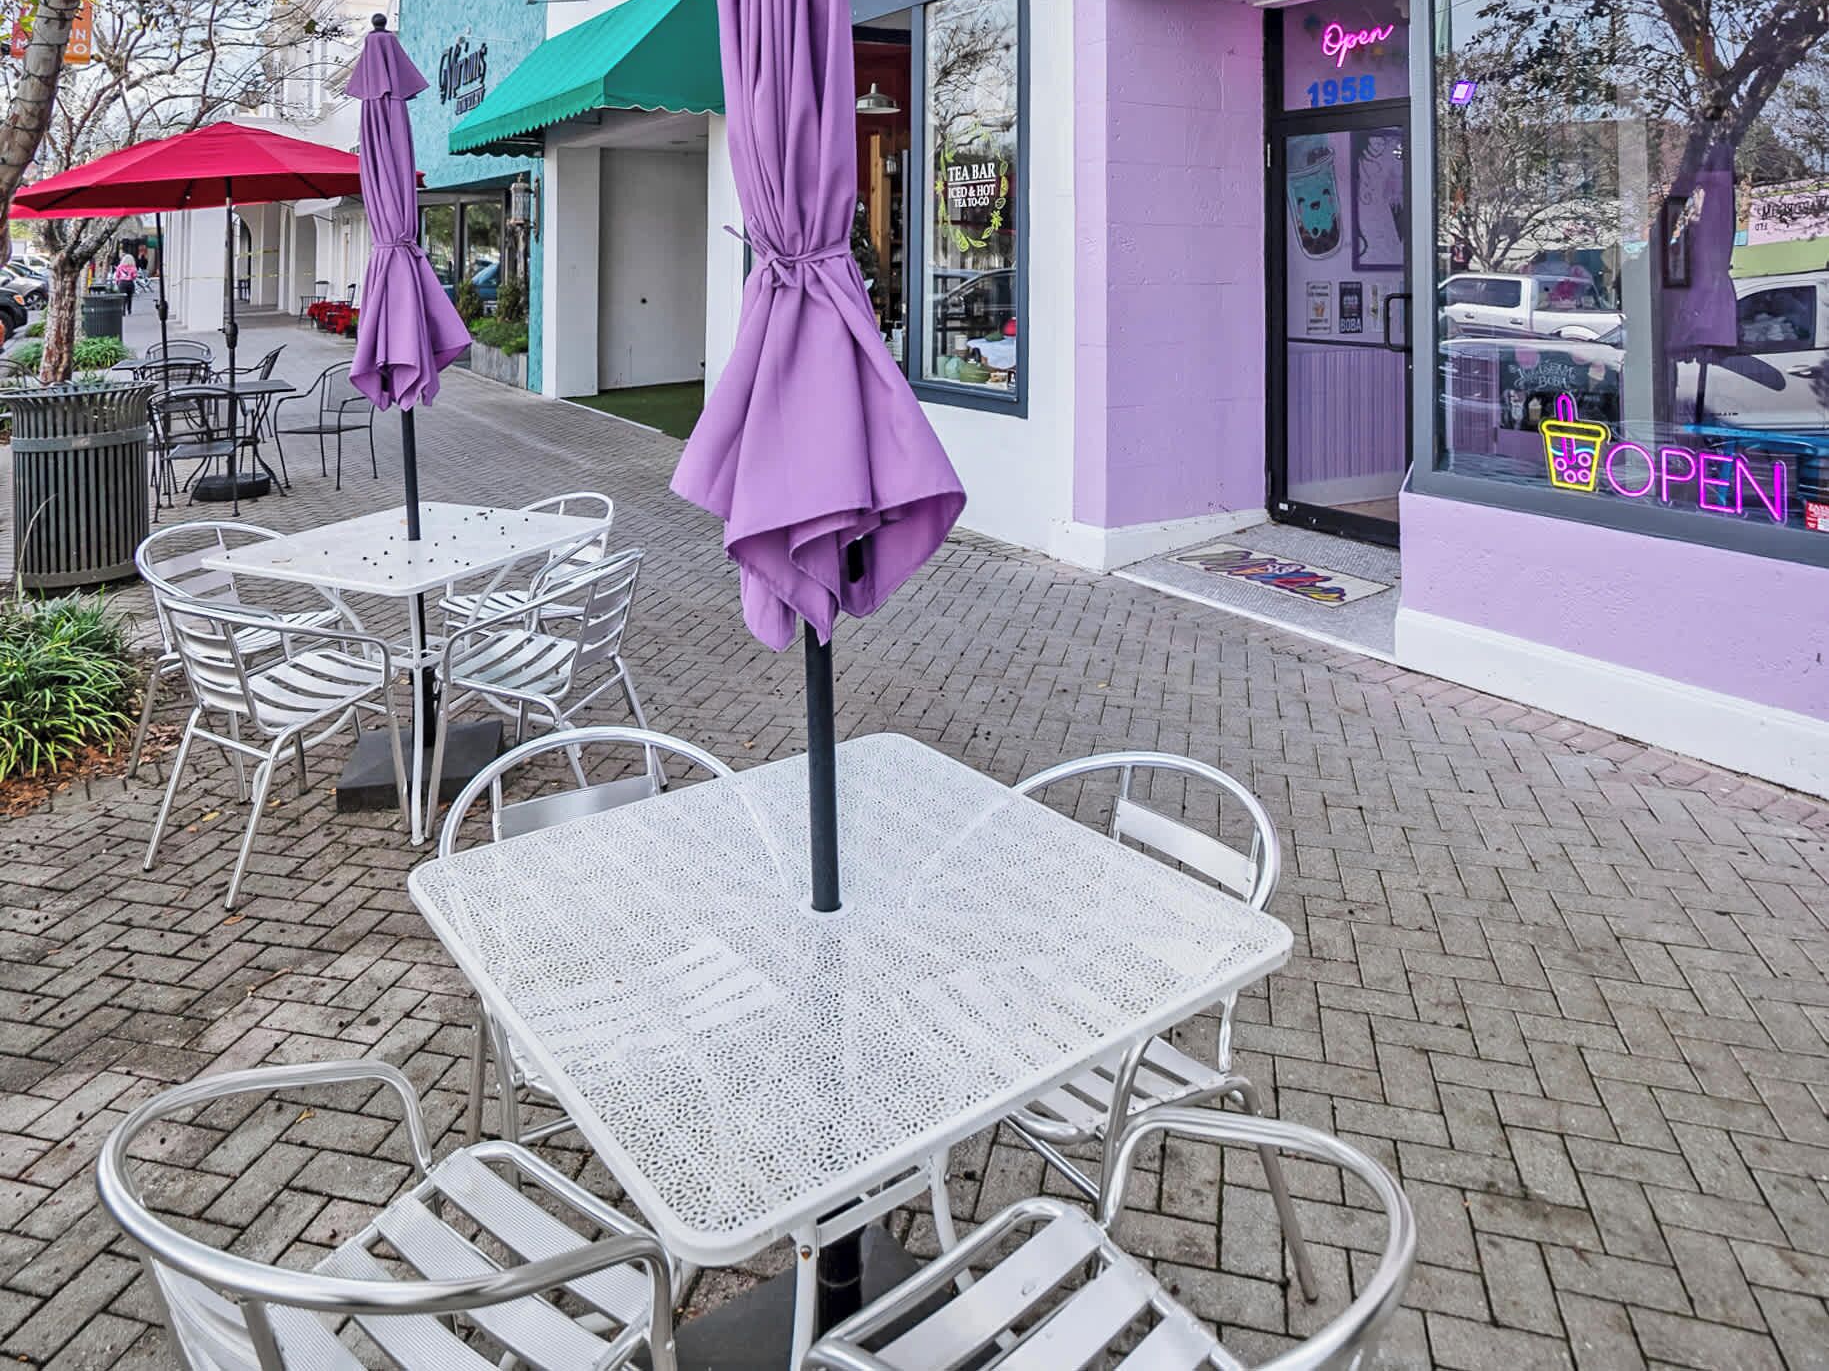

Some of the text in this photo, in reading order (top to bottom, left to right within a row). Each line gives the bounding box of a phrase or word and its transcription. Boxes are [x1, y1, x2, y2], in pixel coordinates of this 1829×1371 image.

[1322, 22, 1395, 68] Open
[1306, 75, 1377, 107] 1958
[947, 162, 996, 182] TEA BAR
[947, 183, 996, 199] ICED & HOT
[954, 198, 967, 208] TEA
[1340, 317, 1362, 332] BOBA
[1605, 441, 1782, 522] OPEN
